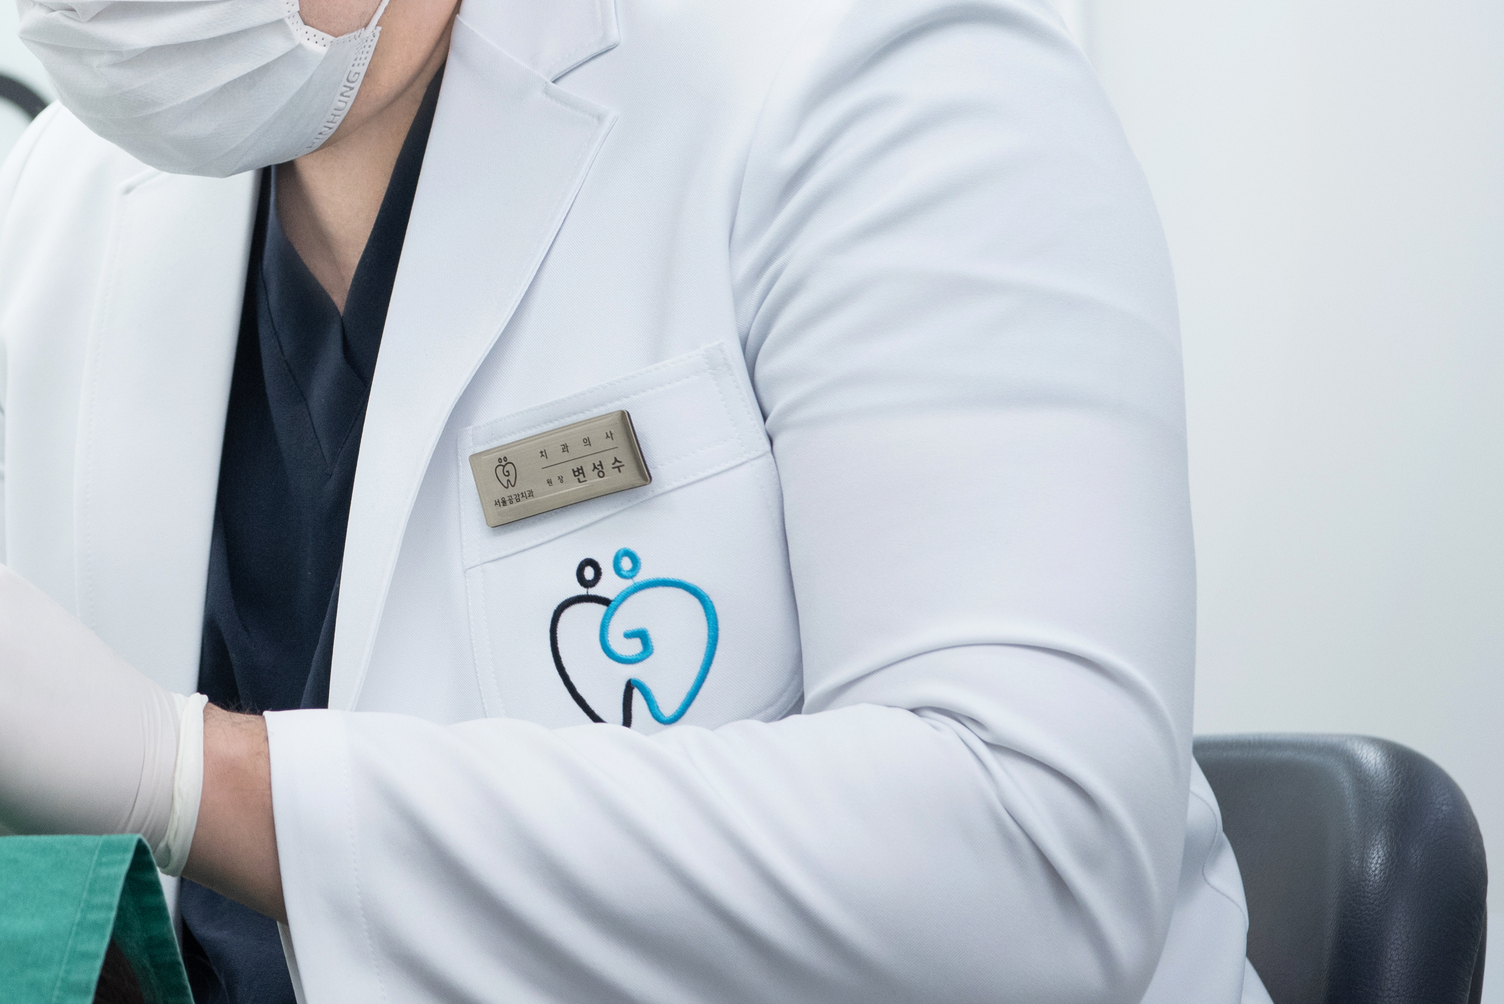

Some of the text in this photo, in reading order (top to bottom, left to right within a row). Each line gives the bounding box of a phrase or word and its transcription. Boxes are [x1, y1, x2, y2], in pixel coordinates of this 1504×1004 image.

[539, 430, 614, 460] 치과의사
[572, 457, 625, 484] 변성수
[494, 489, 535, 507] 서울공감치과
